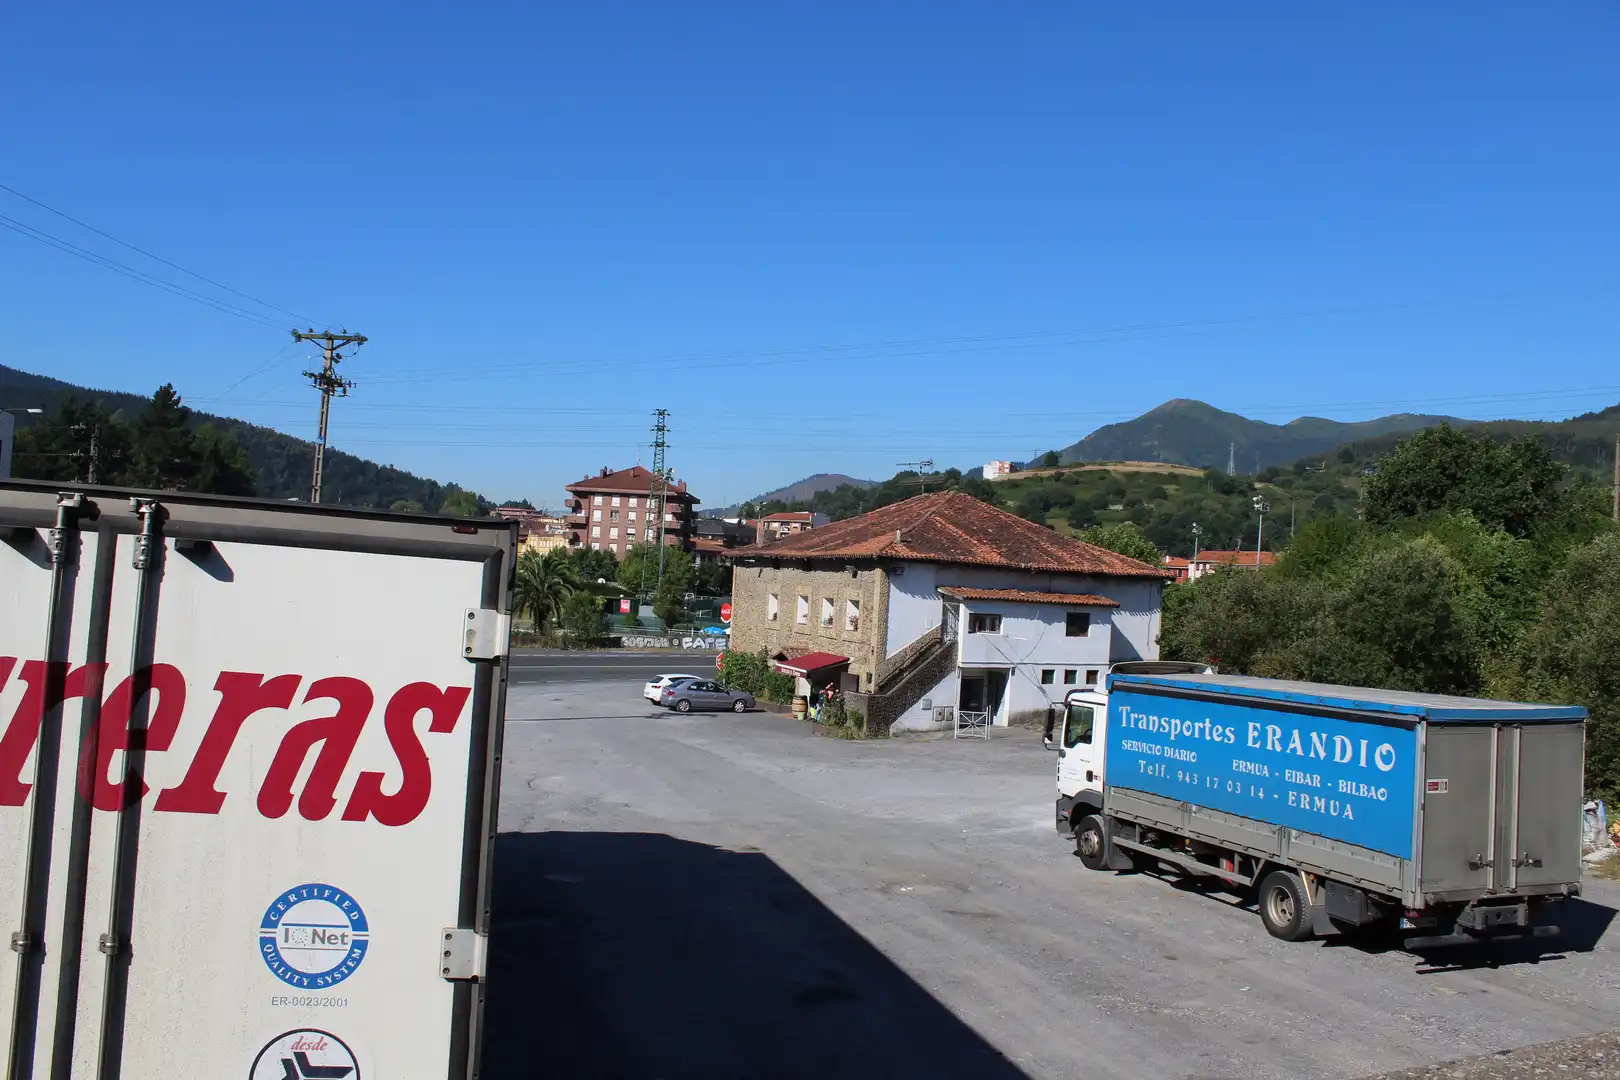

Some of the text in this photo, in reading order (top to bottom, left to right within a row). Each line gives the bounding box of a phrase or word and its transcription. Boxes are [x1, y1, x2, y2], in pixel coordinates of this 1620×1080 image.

[1118, 706, 1396, 772] Transportes ERANDIO
[1122, 739, 1162, 756] SERVICIO
[1164, 746, 1197, 763] DIARIO
[1232, 759, 1269, 777] ERMUA
[1285, 769, 1321, 788] EIBAR
[1338, 779, 1388, 801] BILBAO
[1139, 760, 1170, 779] Telf.
[1177, 770, 1198, 785] 943
[1206, 776, 1219, 789] 17
[1227, 780, 1241, 794] 03
[1251, 785, 1265, 799] 14
[1288, 790, 1354, 820] ERMUA
[270, 888, 359, 921] CERTIFIED
[263, 943, 362, 986] QUALITY SYSTEM
[271, 996, 348, 1008] ER-0023/2001
[291, 1035, 328, 1051] desde
